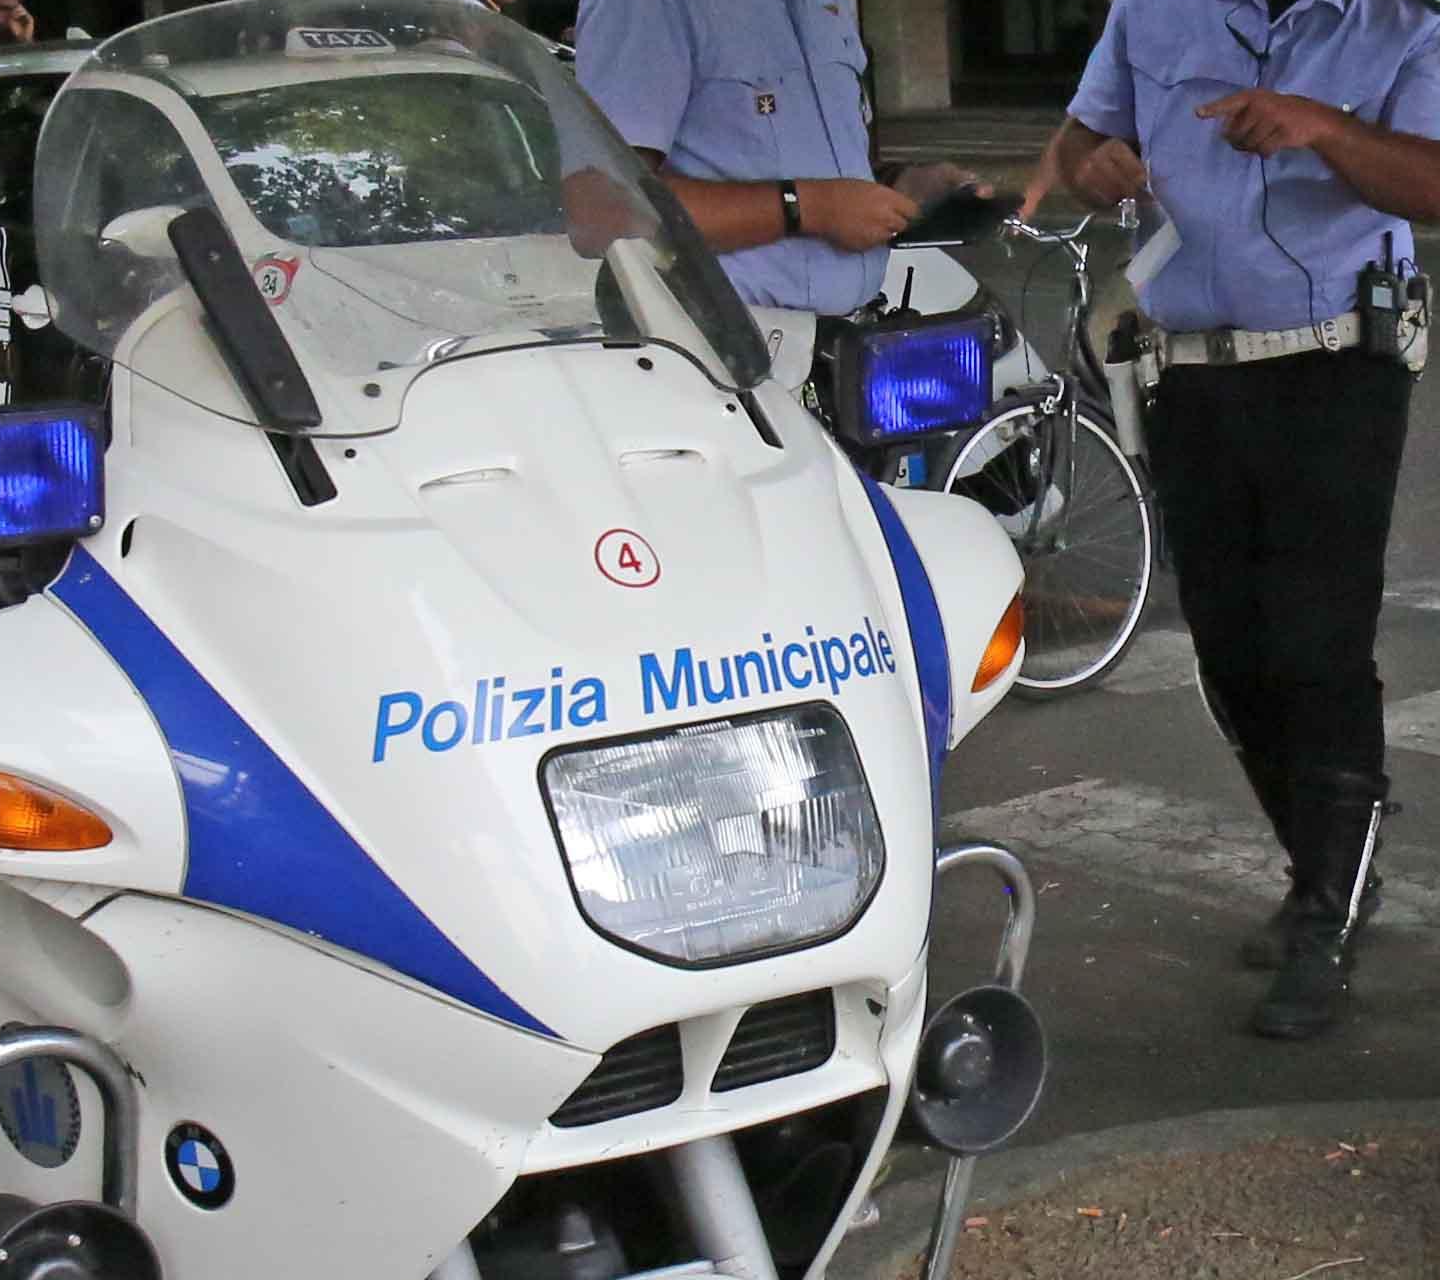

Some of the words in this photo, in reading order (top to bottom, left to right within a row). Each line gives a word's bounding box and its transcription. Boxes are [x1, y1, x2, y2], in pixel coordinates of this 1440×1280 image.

[302, 32, 381, 46] TAXI
[261, 272, 279, 297] 24
[617, 541, 642, 574] 4
[371, 666, 607, 763] Polizia
[638, 616, 897, 714] Municipale
